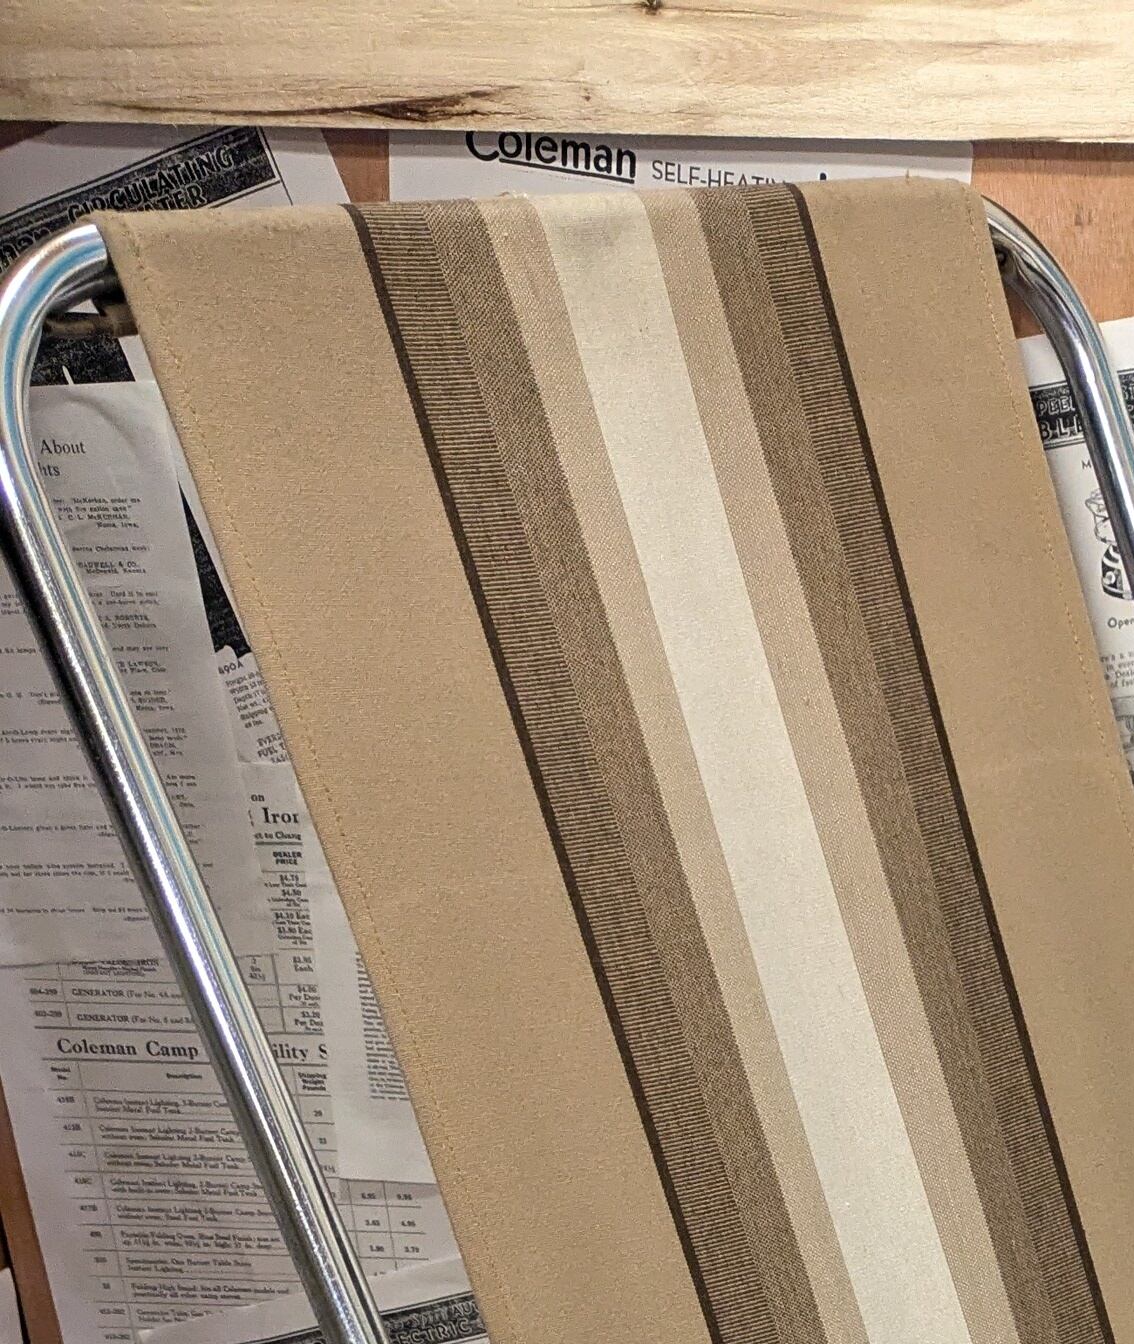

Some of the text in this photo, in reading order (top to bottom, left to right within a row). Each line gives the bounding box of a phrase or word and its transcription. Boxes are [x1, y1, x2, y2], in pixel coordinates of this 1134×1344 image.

[465, 131, 636, 178] Coleman
[40, 439, 86, 455] About
[37, 461, 60, 476] hts
[275, 831, 301, 841] Chang
[57, 1038, 308, 1062] Coleman Camp ility
